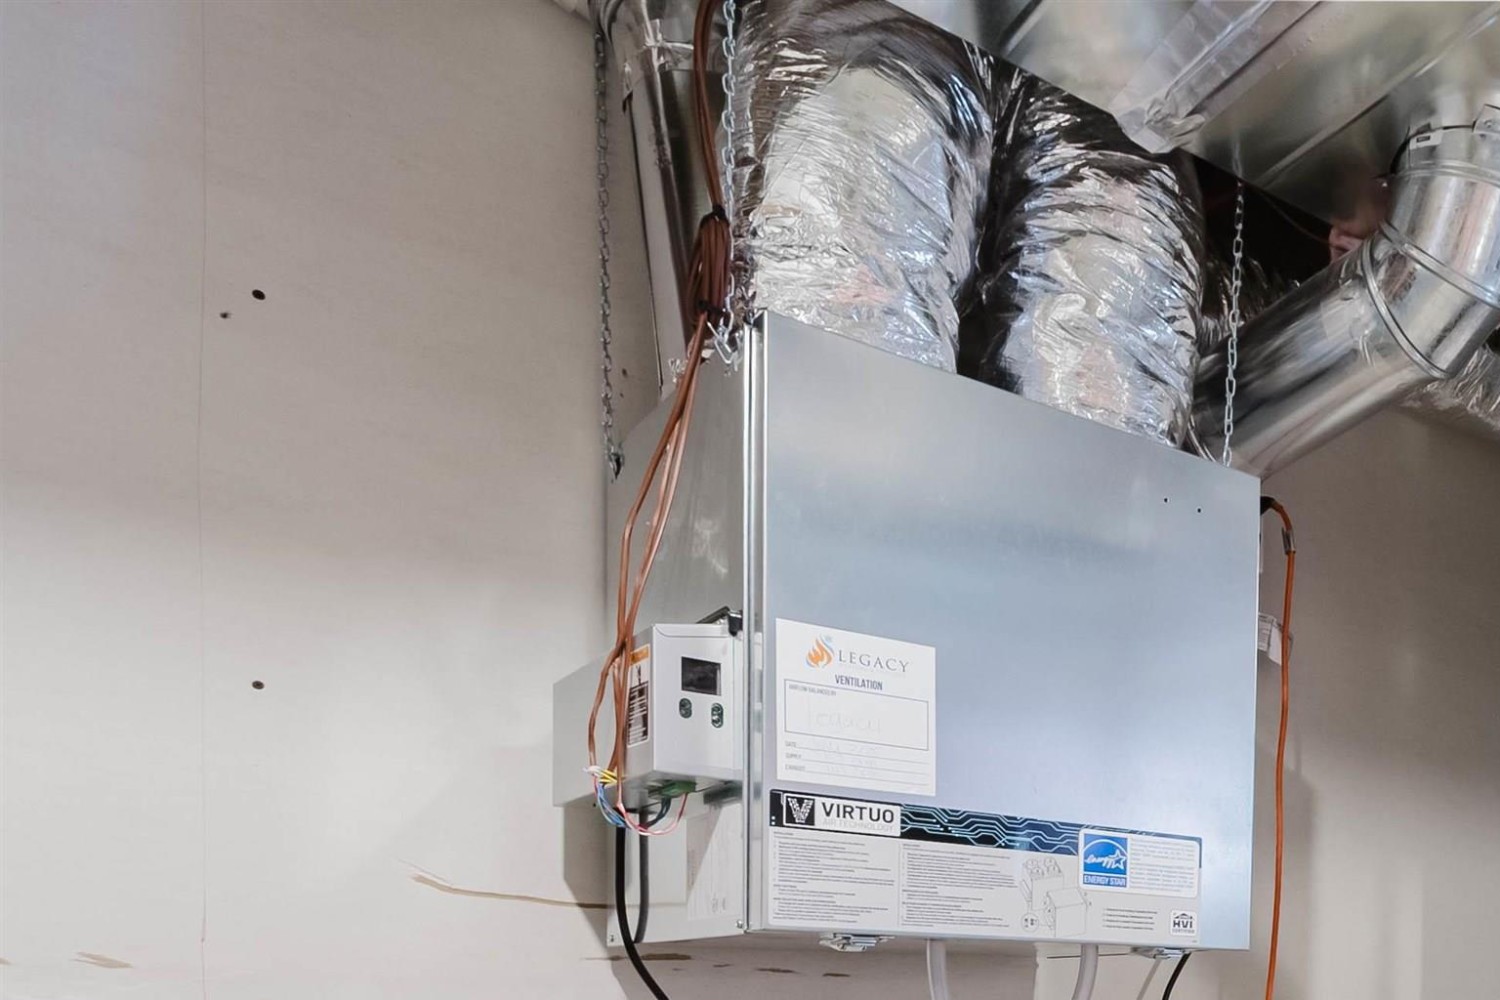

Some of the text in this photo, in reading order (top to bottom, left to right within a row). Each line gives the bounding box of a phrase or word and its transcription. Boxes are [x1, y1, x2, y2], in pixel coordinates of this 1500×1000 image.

[839, 649, 910, 672] LEGACY
[835, 674, 883, 690] VENTILATION
[822, 802, 894, 824] VIRTUO
[1084, 875, 1126, 886] ENERGY STAR
[1173, 920, 1193, 928] HVI
